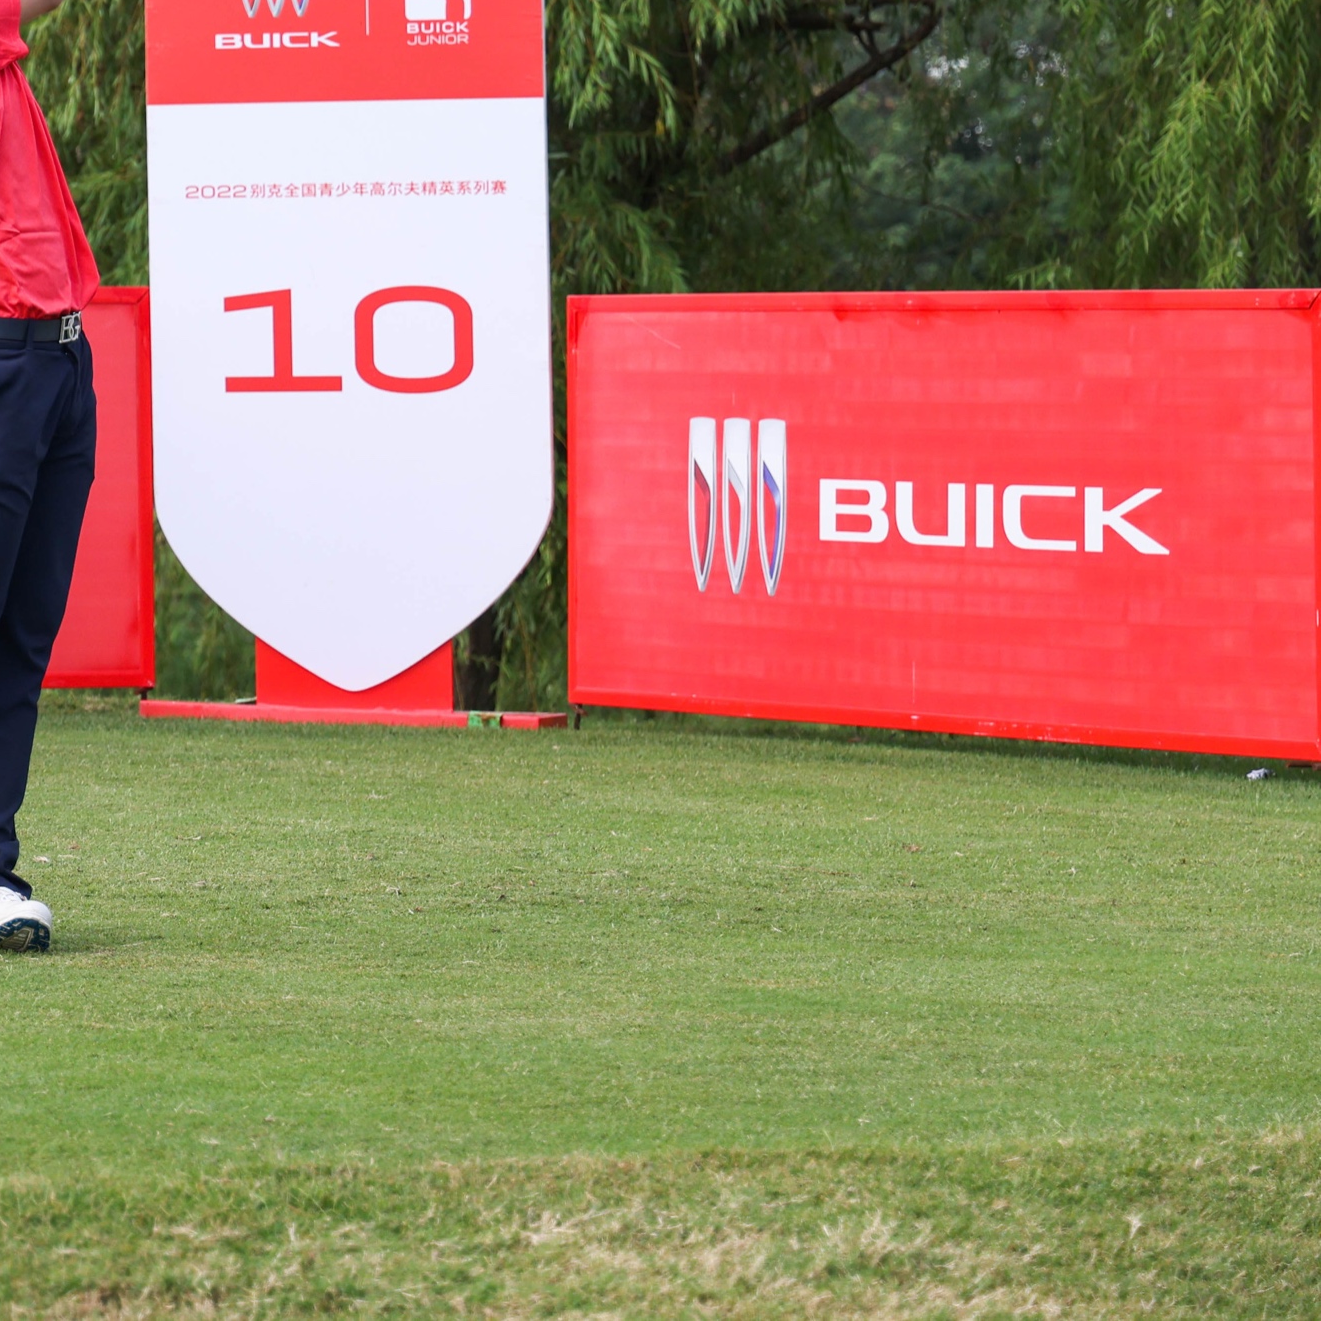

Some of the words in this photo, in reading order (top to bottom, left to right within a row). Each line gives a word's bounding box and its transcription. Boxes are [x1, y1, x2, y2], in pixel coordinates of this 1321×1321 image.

[406, 21, 469, 34] BUICK
[214, 31, 340, 50] BUICK
[406, 33, 469, 46] JUNIOR
[185, 179, 508, 199] 2022别克全国青少年高尔夫精英系列赛
[223, 285, 474, 394] 10
[819, 478, 1170, 555] BUICK
